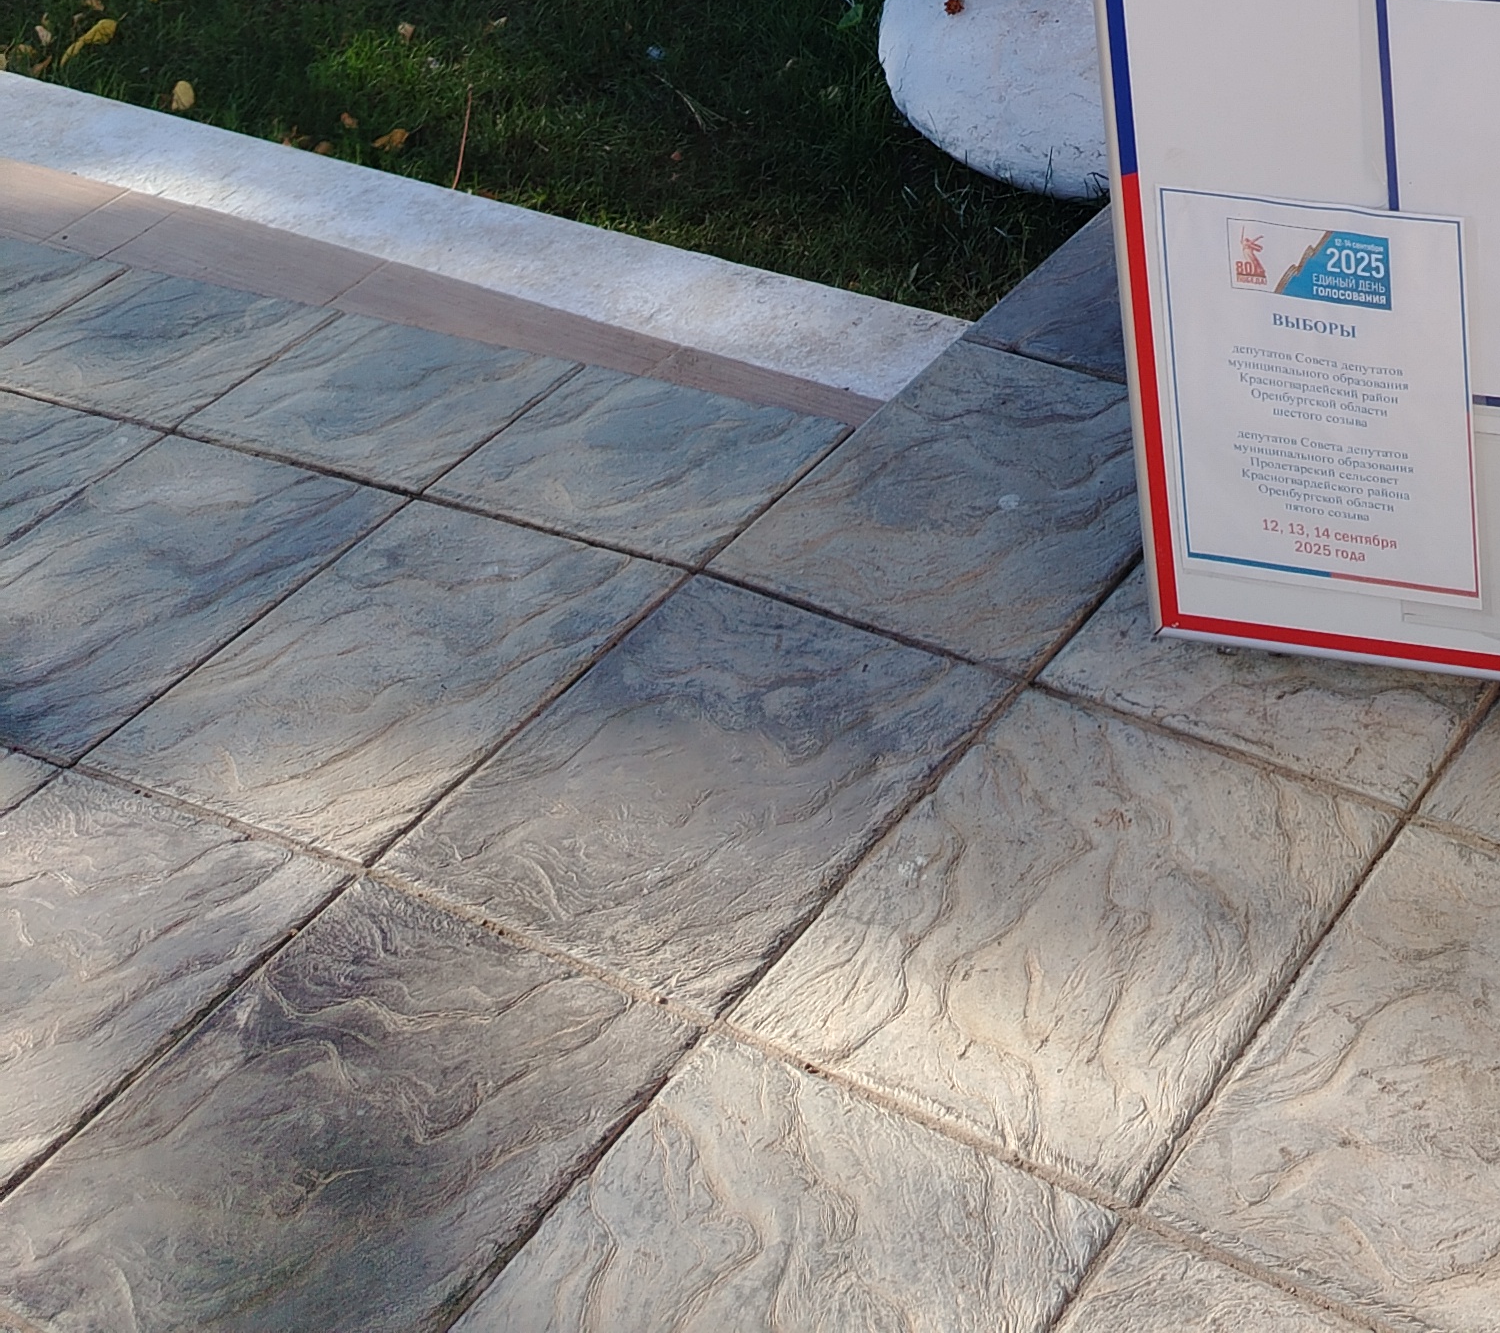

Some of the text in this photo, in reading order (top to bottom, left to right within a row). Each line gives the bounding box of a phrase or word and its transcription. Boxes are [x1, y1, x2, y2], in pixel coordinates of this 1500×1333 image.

[1235, 261, 1252, 274] 80
[1326, 248, 1385, 279] 2025
[1312, 273, 1385, 293] ЕДИНЫЙ ДЕНЬ
[1313, 287, 1386, 304] голосования
[1273, 312, 1356, 338] ВЫБОРЫ
[1228, 359, 1409, 390] муниципального образования
[1232, 345, 1403, 376] депутатов Совета депутатов
[1239, 373, 1398, 404] Красногвардейский район
[1251, 388, 1388, 417] Оренбургской области
[1273, 409, 1367, 427] шестого созыва
[1233, 444, 1414, 473] муниципального образования
[1237, 430, 1408, 459] депутатов Совета депутатов
[1250, 457, 1399, 485] Пролетарский сельсовет
[1258, 484, 1394, 512] Оренбургской области
[1367, 489, 1410, 501] района
[1285, 502, 1369, 521] пятого созыва
[1263, 519, 1397, 550] 12, 13, 14 сентября
[1294, 541, 1366, 562] 2025 года
